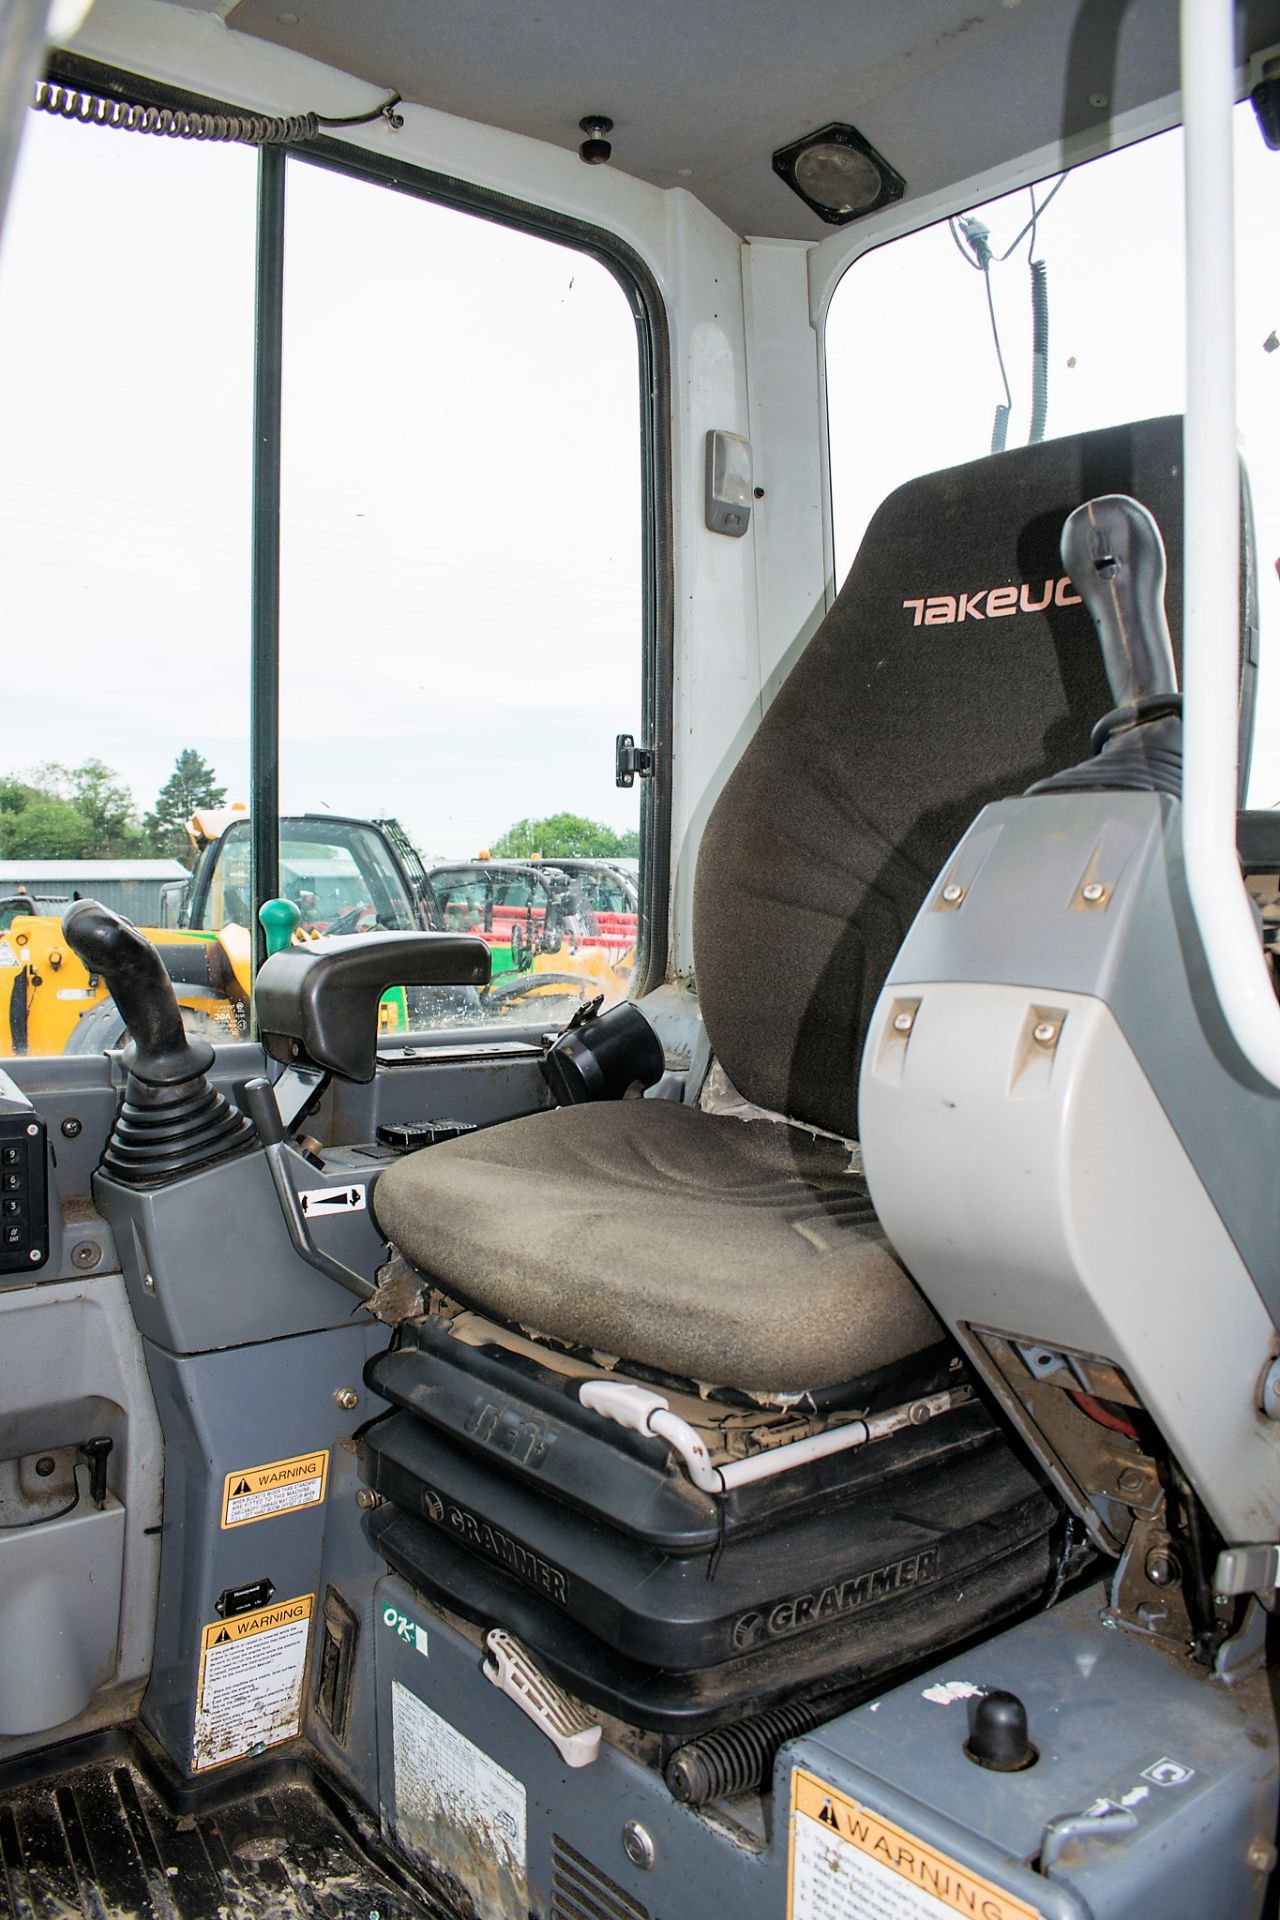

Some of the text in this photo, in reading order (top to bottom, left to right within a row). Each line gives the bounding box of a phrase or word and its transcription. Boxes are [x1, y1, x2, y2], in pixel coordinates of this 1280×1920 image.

[9, 1150, 16, 1158] 9
[10, 1175, 16, 1184] 6
[10, 1202, 16, 1210] 3
[258, 1463, 316, 1486] WARNING
[448, 1505, 566, 1604] GRAMMER
[768, 1548, 941, 1634] GRAMMER
[238, 1605, 303, 1634] WARNING
[847, 1815, 1004, 1920] WARNING
